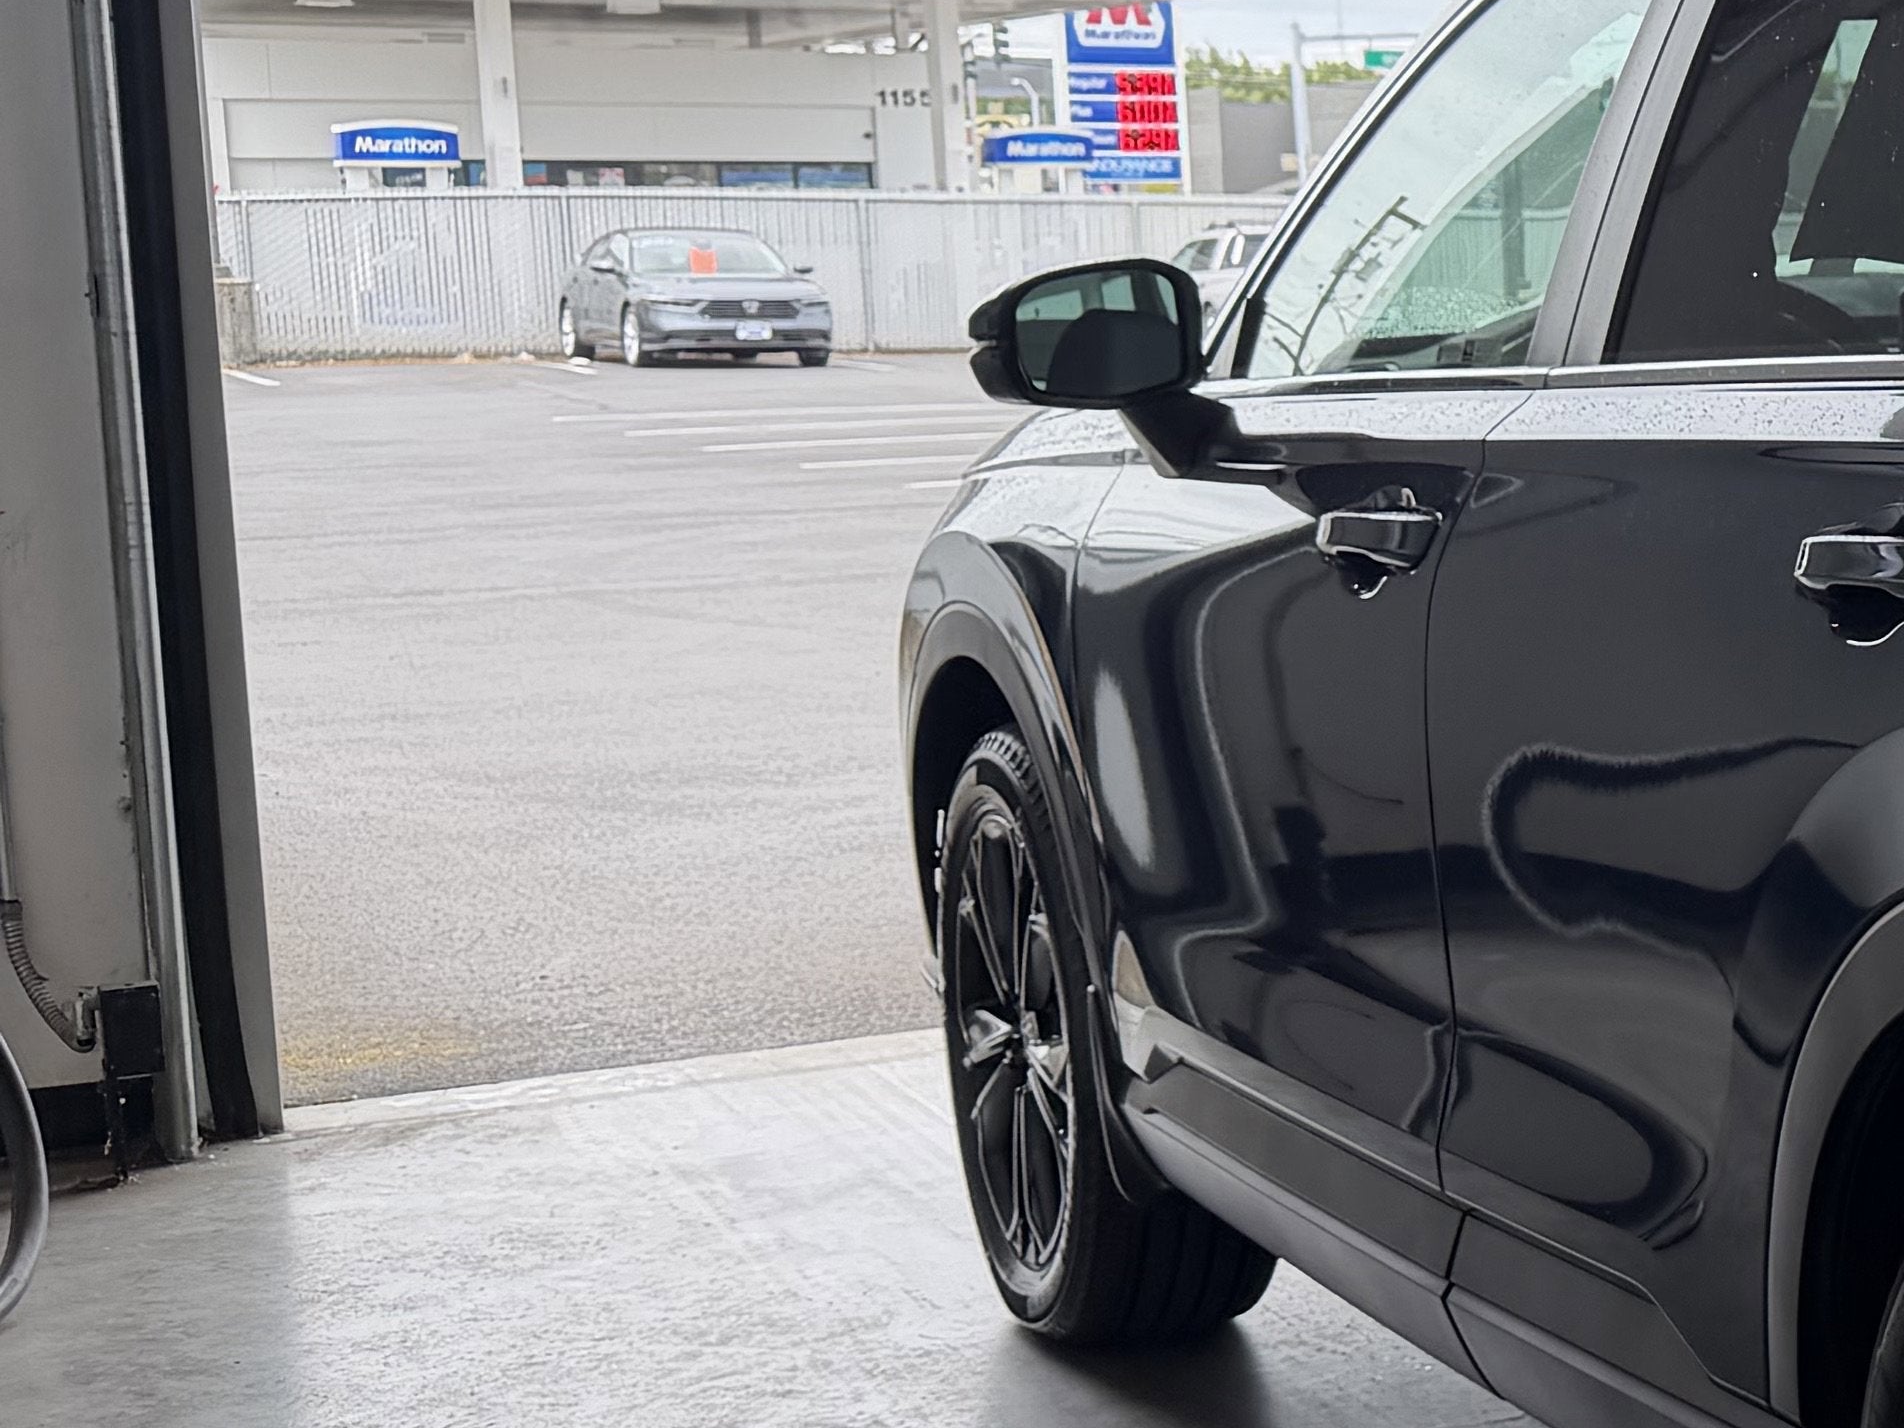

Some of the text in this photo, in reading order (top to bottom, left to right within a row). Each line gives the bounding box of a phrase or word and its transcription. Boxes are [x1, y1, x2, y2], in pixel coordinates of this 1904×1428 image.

[1085, 29, 1156, 41] Marathon
[355, 136, 447, 155] Marathon
[1006, 139, 1086, 158] Marathon
